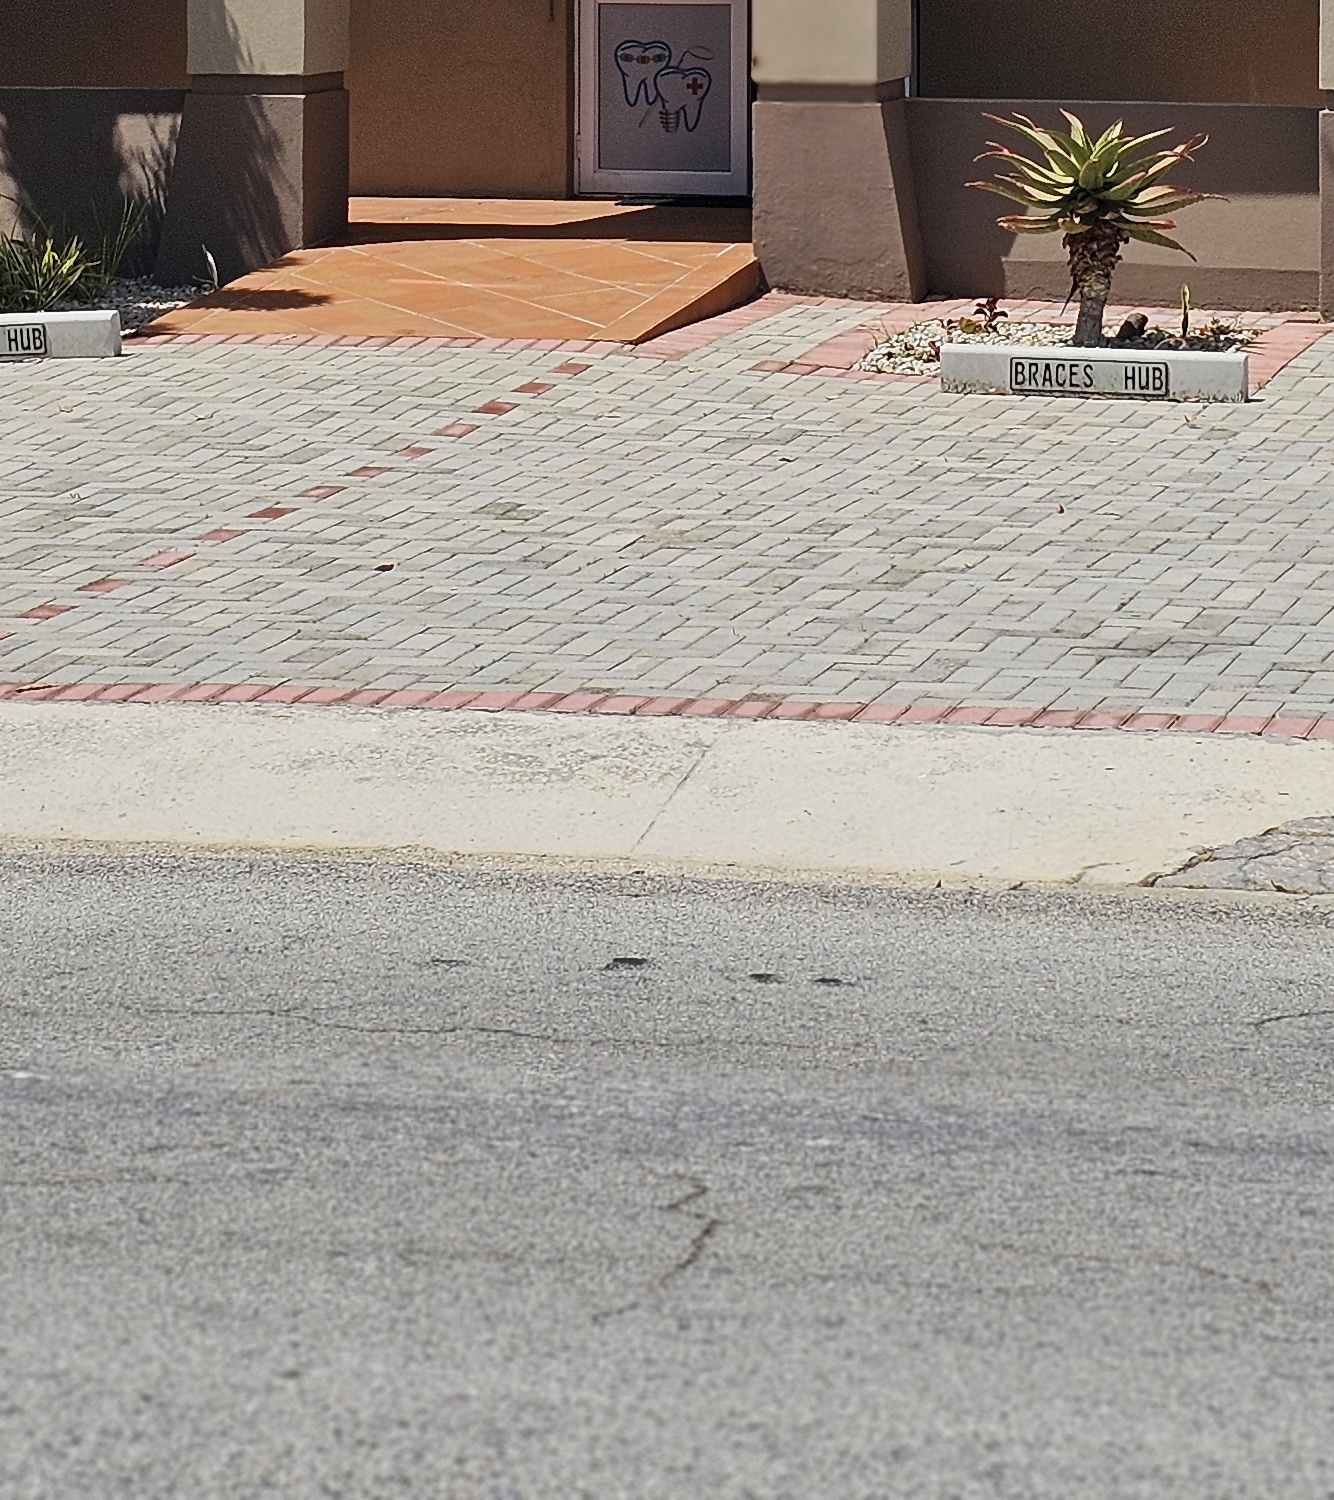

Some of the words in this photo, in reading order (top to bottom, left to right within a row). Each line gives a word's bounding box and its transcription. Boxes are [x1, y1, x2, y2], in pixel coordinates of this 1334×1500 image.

[8, 328, 43, 352] HUB
[1014, 361, 1094, 388] BRACES
[1124, 365, 1163, 391] HUB
